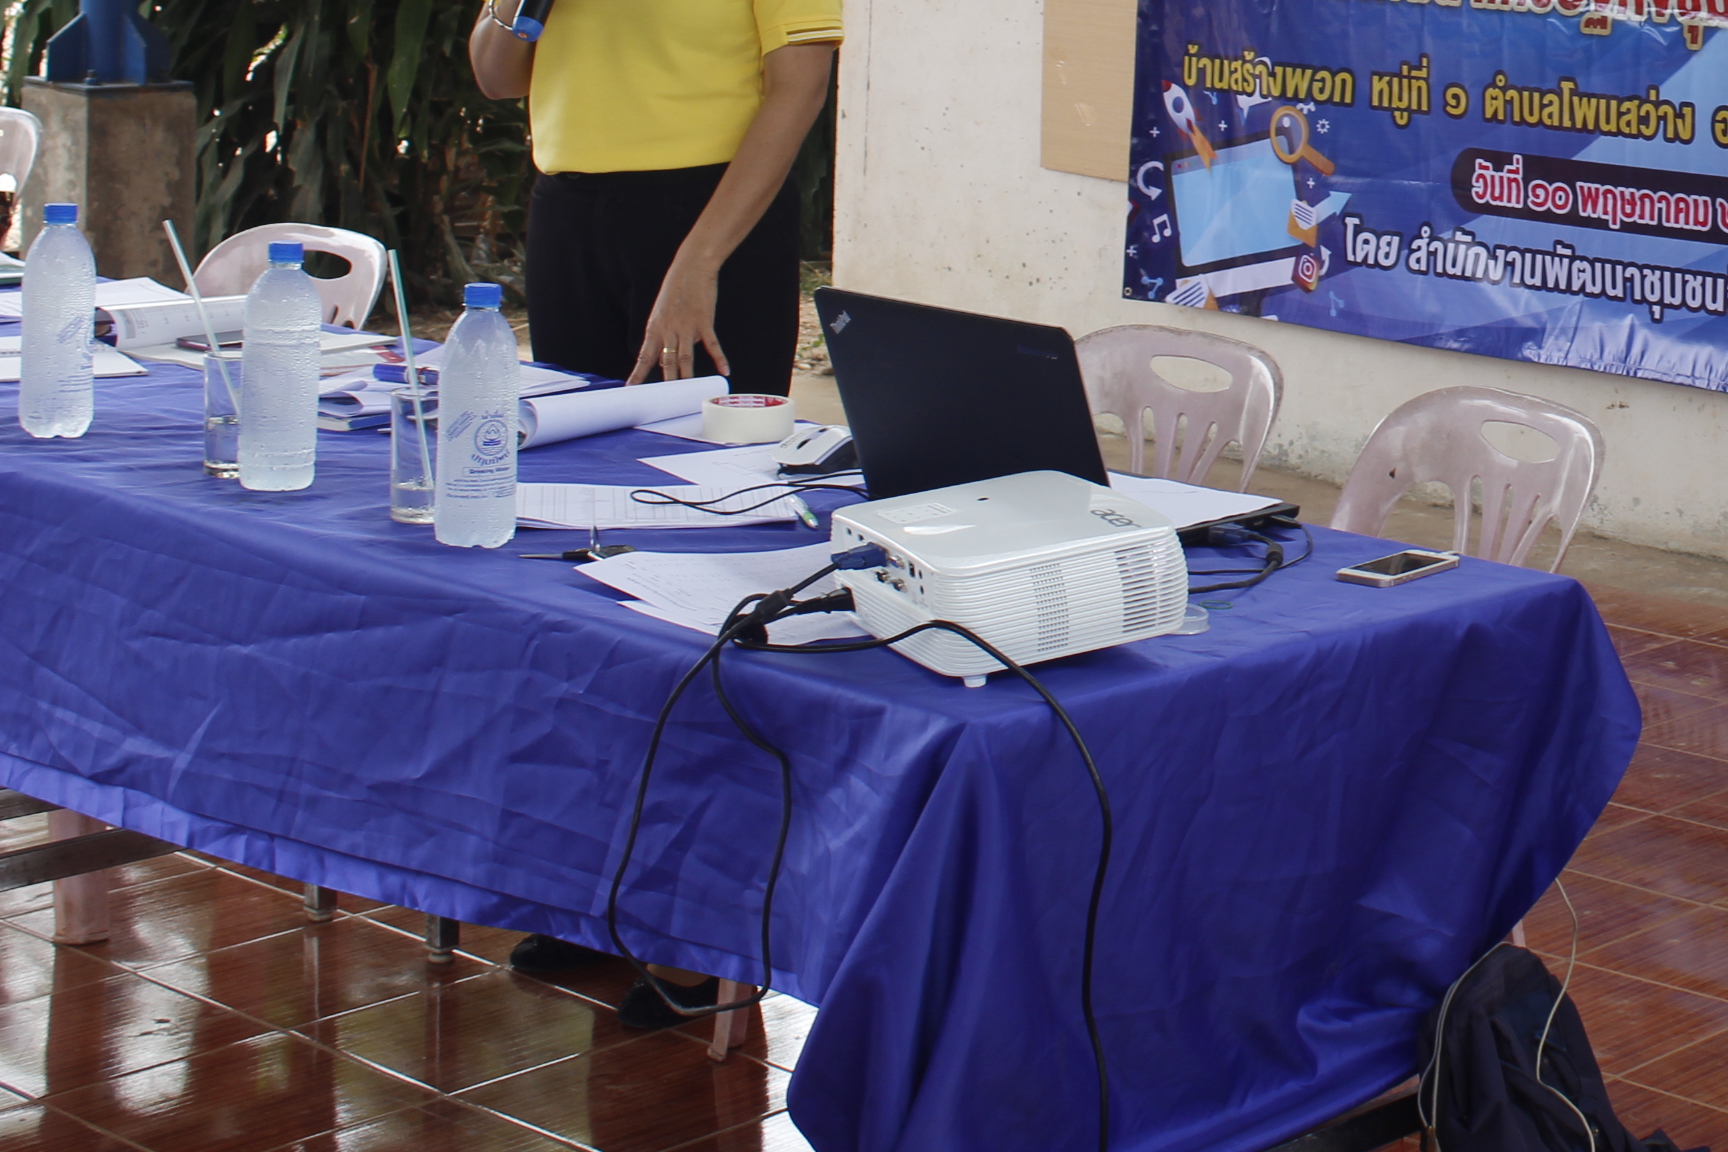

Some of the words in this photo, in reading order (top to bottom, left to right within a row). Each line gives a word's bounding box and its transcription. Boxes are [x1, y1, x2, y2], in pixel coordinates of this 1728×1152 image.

[1182, 43, 1353, 105] บ้านสร้างพอก
[1370, 56, 1430, 127] หมู่ที่
[1483, 74, 1694, 142] ตำบลโพนสว่าง
[1471, 154, 1523, 209] วันที่
[1527, 180, 1572, 214] ๑๐
[1577, 179, 1712, 230] พฤษภาคม
[1344, 217, 1399, 268] โดย
[1089, 508, 1142, 528] acer
